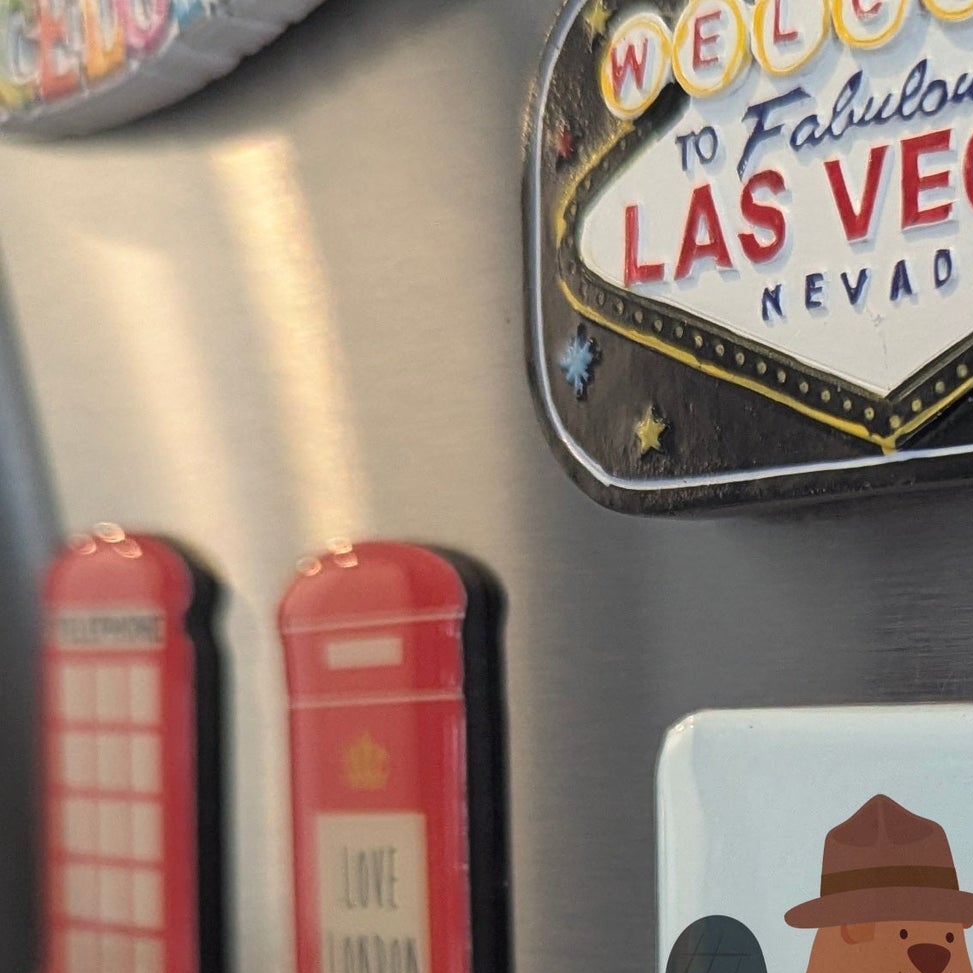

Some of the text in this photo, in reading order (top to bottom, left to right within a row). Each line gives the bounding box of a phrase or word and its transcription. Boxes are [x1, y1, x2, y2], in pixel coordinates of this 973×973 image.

[676, 124, 718, 171] TO
[623, 169, 785, 285] LAS
[342, 846, 399, 909] LOVE
